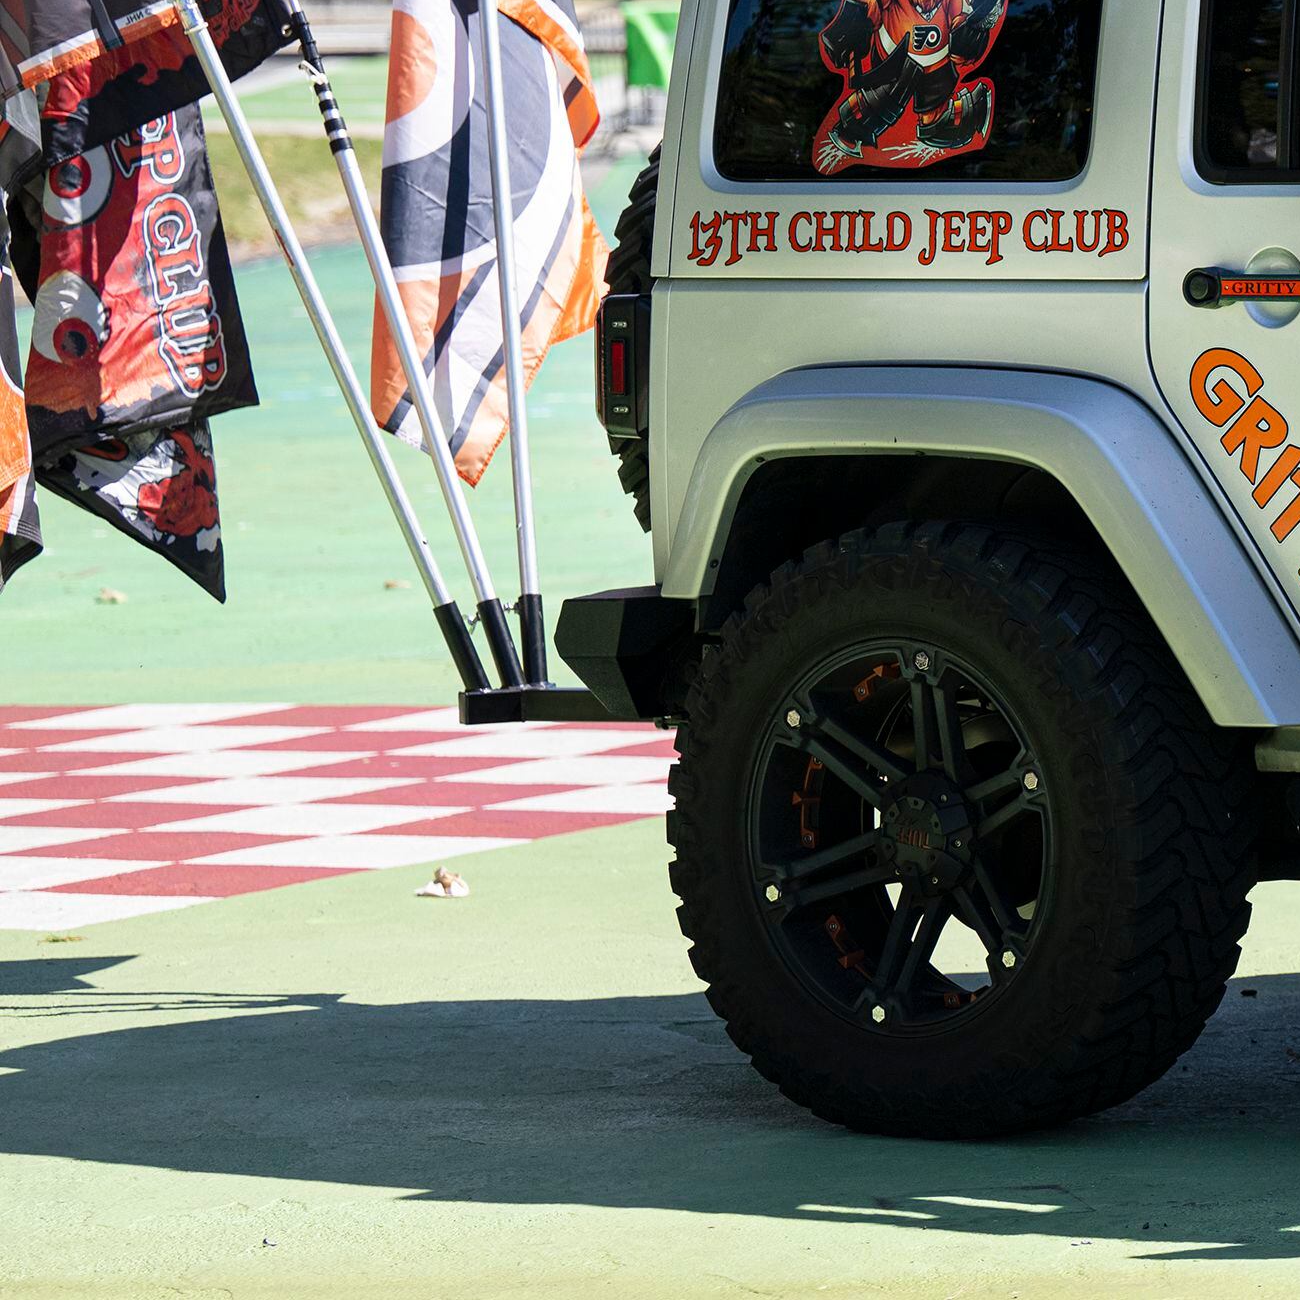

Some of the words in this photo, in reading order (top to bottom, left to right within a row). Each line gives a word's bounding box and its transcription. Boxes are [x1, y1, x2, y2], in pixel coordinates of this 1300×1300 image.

[687, 210, 780, 267] 13TH
[787, 210, 912, 255] CHILD
[917, 208, 1014, 267] JEEP
[1021, 208, 1131, 259] CLUB
[143, 192, 228, 398] CLUB
[1231, 282, 1297, 294] GRITTY
